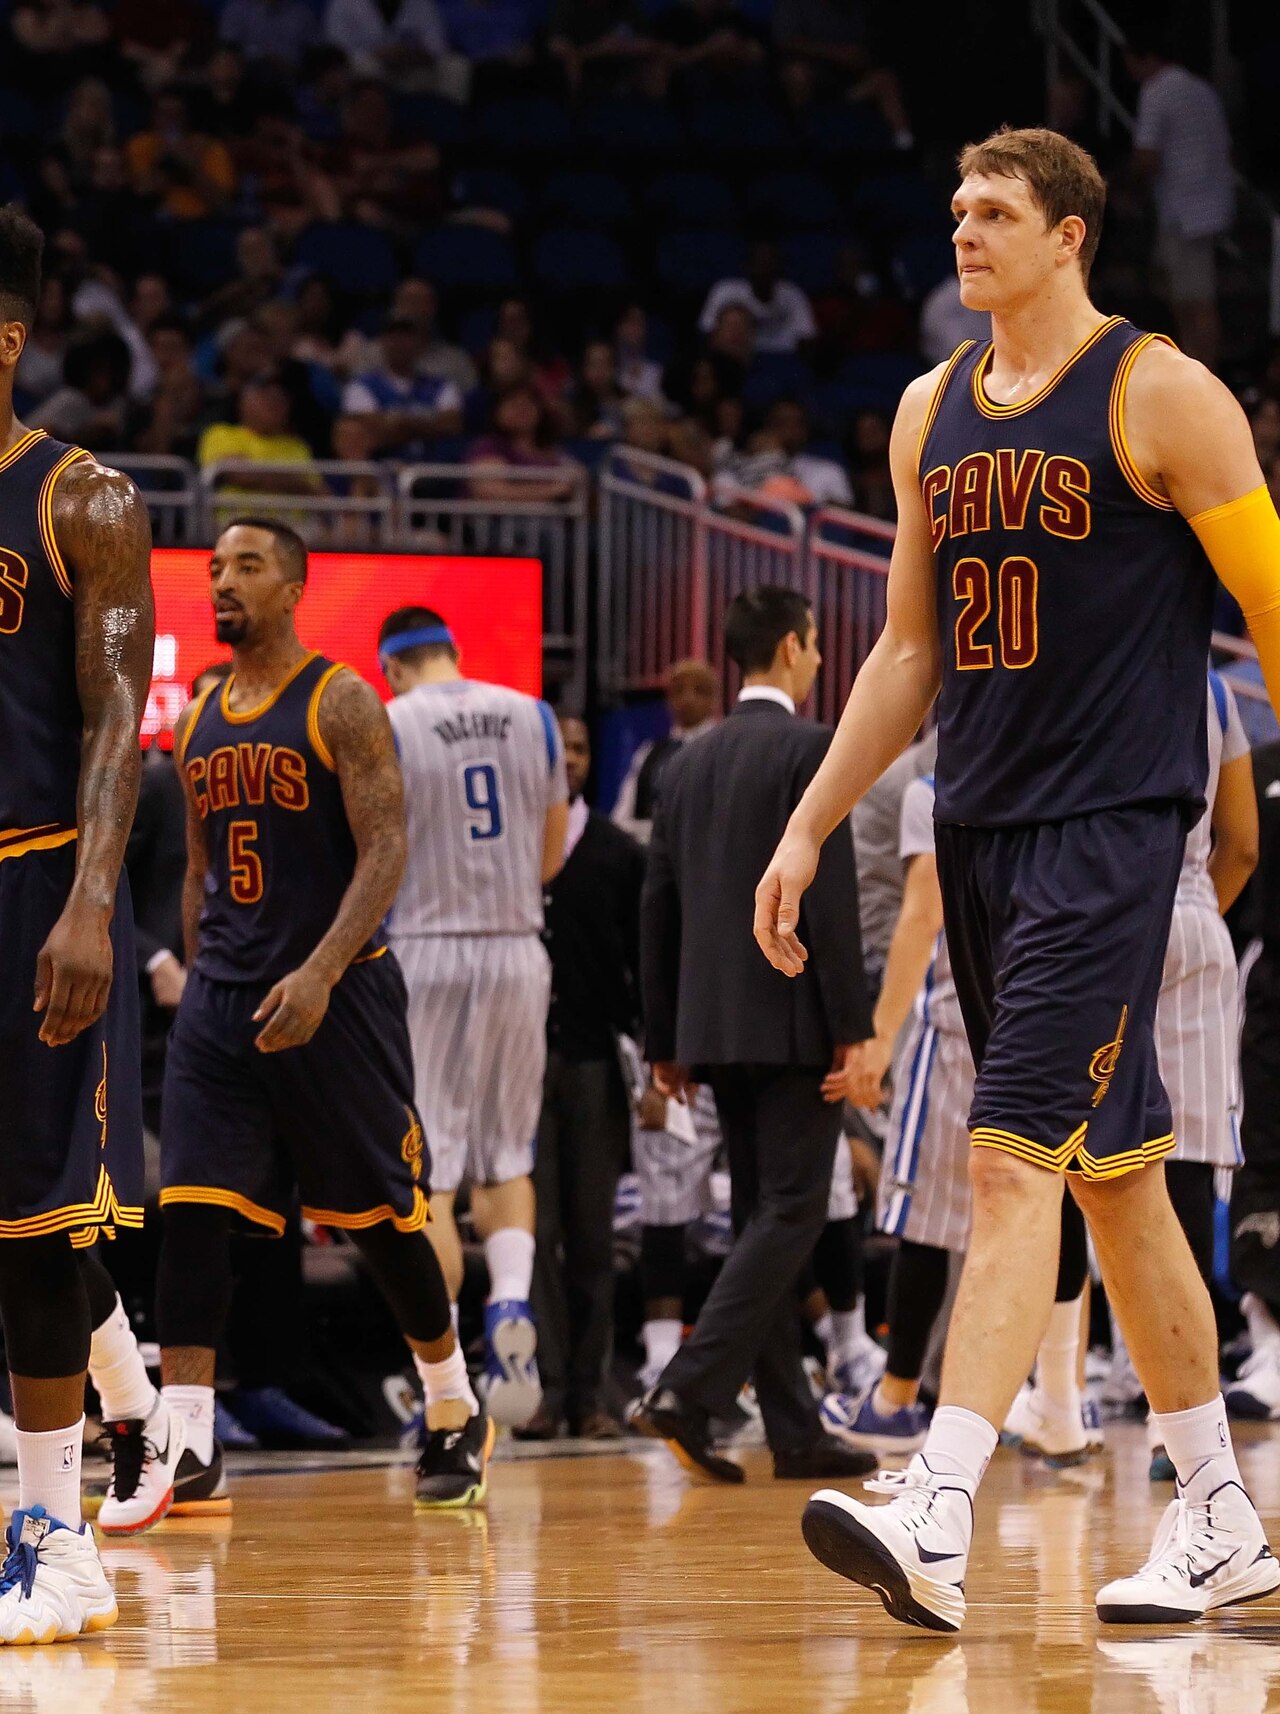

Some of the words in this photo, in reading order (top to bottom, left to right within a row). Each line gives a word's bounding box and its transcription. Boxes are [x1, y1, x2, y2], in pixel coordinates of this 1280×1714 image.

[922, 449, 1091, 553] CAVS
[952, 556, 1038, 671] 20
[464, 764, 502, 842] 9
[228, 820, 264, 904] 5
